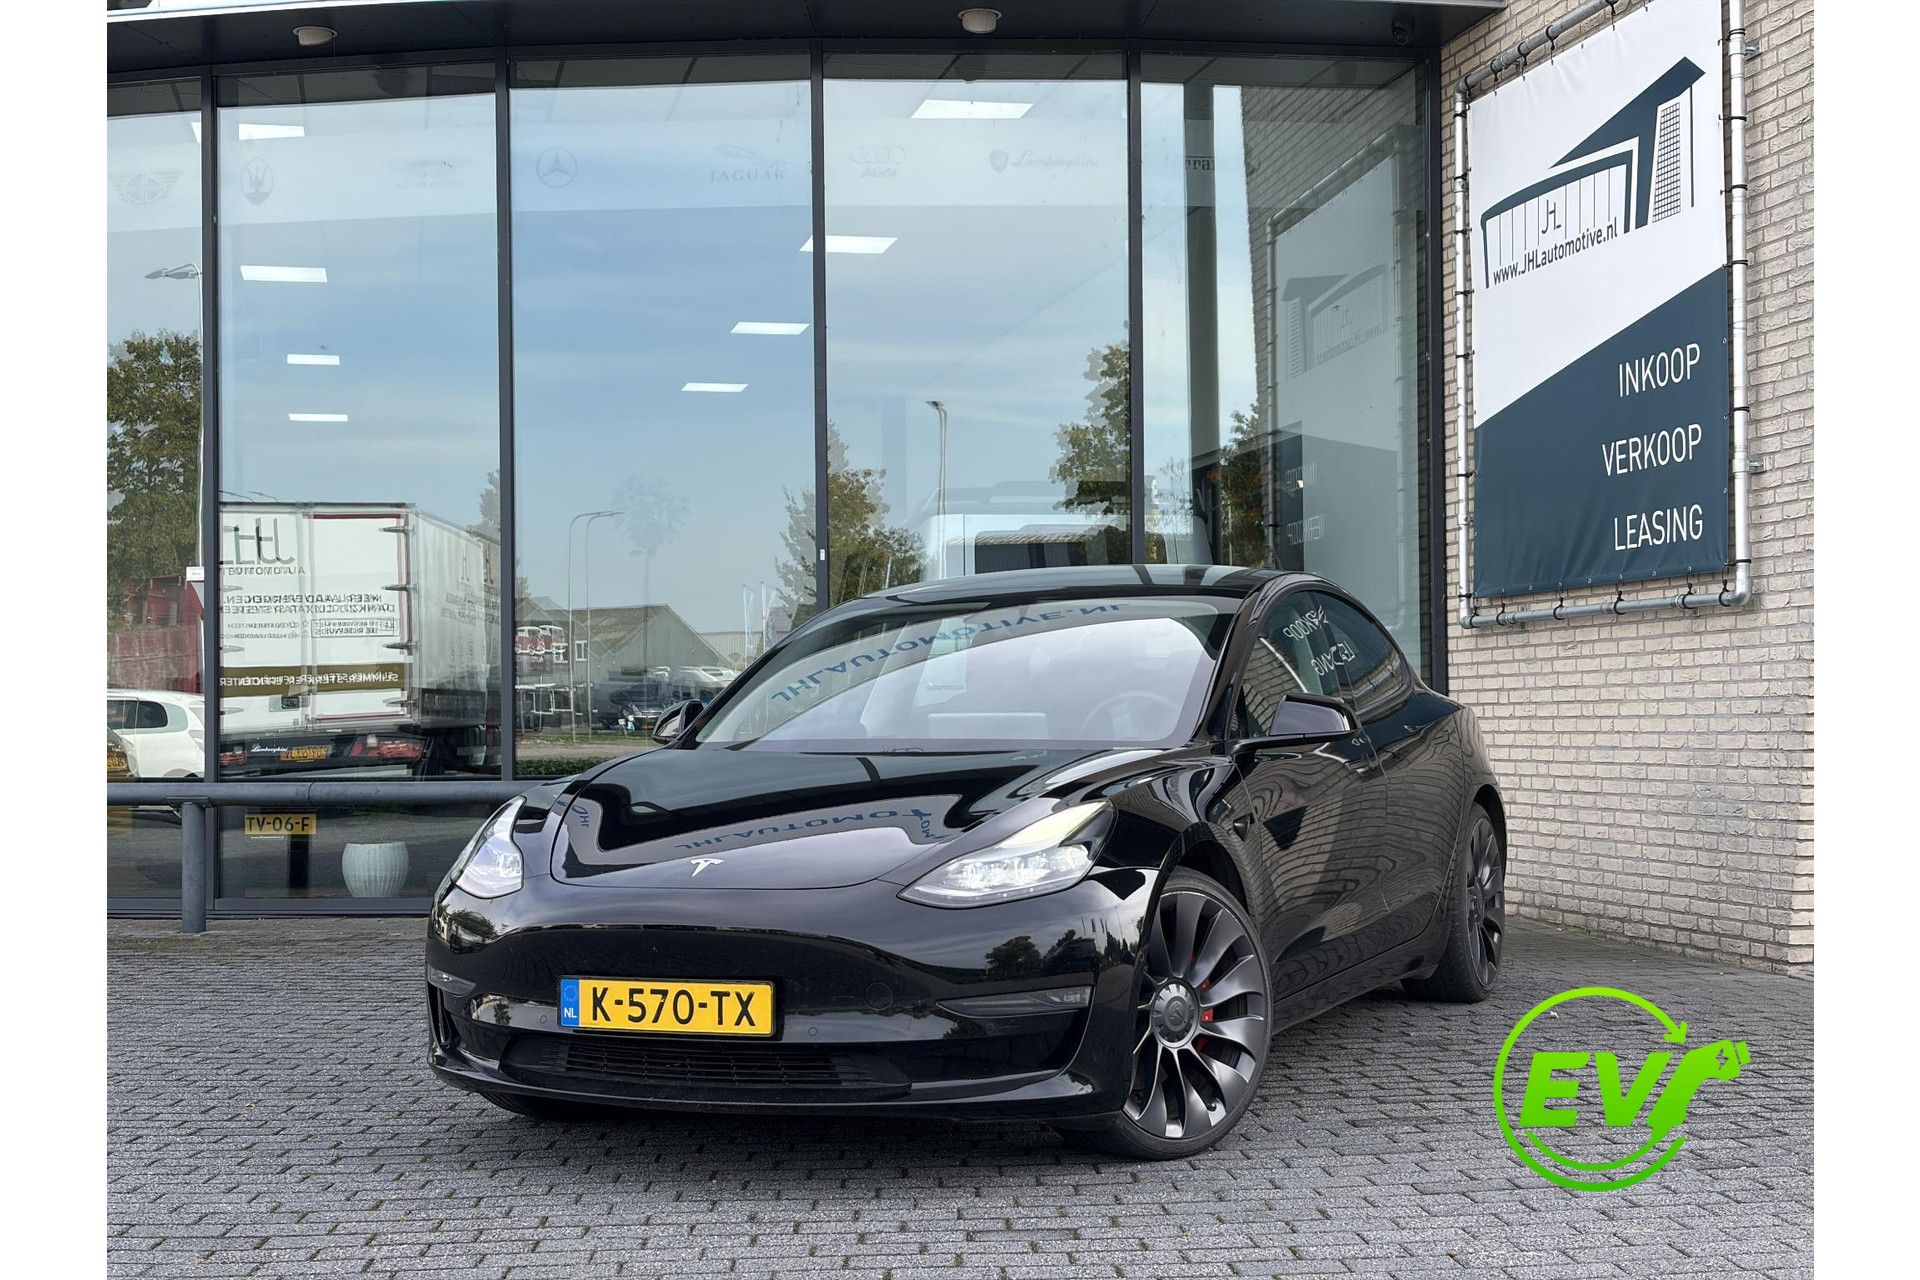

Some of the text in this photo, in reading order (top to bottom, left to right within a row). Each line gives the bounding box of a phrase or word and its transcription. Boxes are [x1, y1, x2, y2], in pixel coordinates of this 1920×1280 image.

[1493, 217, 1618, 286] www.JHLautomotive.nl
[1619, 343, 1701, 398] INKOOP
[1602, 424, 1702, 476] VERKOOP
[1613, 504, 1703, 551] LEASING
[246, 816, 310, 832] TV-06-F
[564, 987, 756, 1027] NL K-570-TX
